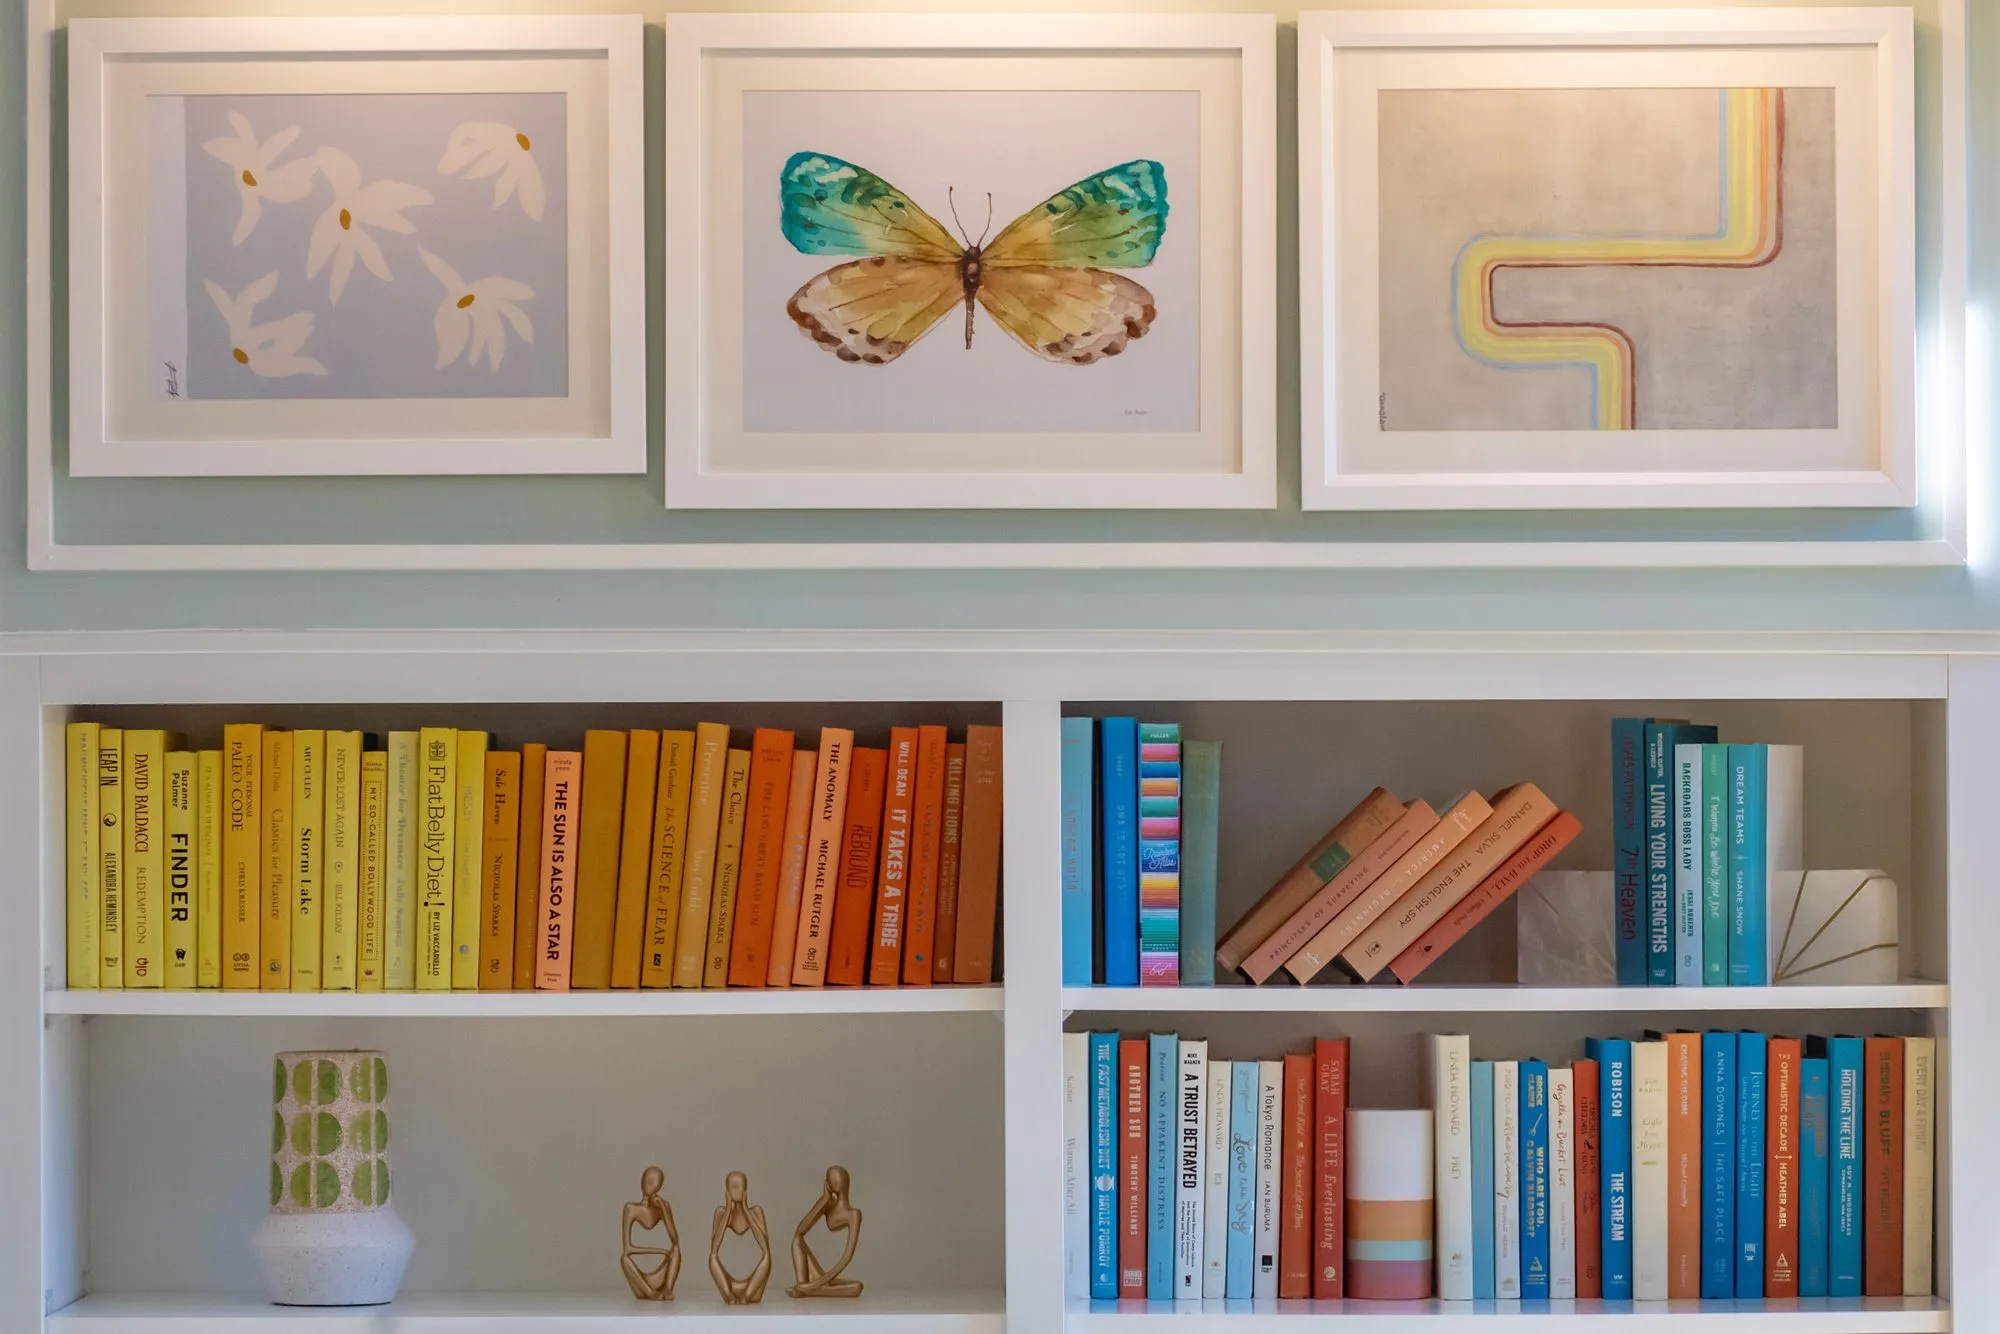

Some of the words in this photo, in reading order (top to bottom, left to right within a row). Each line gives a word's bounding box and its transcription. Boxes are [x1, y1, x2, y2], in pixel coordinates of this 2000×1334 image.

[100, 748, 118, 772] LEAP
[135, 753, 149, 790] DAVID
[231, 741, 244, 783] PALEO
[304, 745, 312, 763] ART
[335, 748, 346, 785] NEVER
[829, 742, 841, 765] THE
[898, 741, 911, 766] WILL
[100, 776, 118, 787] IN
[172, 772, 181, 808] Palmer
[181, 769, 190, 811] Suzanne
[369, 787, 377, 801] MY
[494, 768, 506, 789] Safe
[554, 781, 568, 811] THE
[731, 769, 745, 789] The
[823, 767, 838, 823] ANOMALY
[895, 767, 908, 797] DEAN
[946, 757, 963, 811] KILLING
[1682, 762, 1692, 819] BACKROADS
[1735, 766, 1745, 805] DREAM
[231, 787, 244, 832] CODE
[335, 785, 346, 811] LOST
[665, 807, 675, 823] The
[728, 792, 742, 825] Choice
[891, 808, 907, 824] IT
[1649, 784, 1666, 828] LIVING
[135, 795, 149, 853] BALDACCI
[271, 808, 283, 853] Classics
[334, 813, 345, 848] AGAIN
[368, 804, 377, 863] SO-CALLED
[553, 814, 567, 846] SUN
[944, 812, 959, 845] LIONS
[1503, 801, 1533, 833] DANIEL
[1682, 821, 1692, 846] BOSS
[1735, 807, 1745, 845] TEAMS
[300, 828, 313, 873] Storm
[552, 850, 564, 863] IS
[658, 825, 675, 893] SCIENCE
[846, 824, 873, 889] REBOUND
[886, 829, 906, 881] TAKES
[1476, 829, 1502, 856] SILVA
[1531, 835, 1557, 859] DROP
[1651, 830, 1667, 869] YOUR
[1682, 846, 1692, 871] LADY
[105, 852, 116, 895] ALEXANDRA
[171, 833, 189, 922] FINDER
[238, 862, 247, 888] CHRIS
[814, 839, 829, 891] MICHAEL
[1454, 859, 1472, 879] THE
[271, 873, 283, 920] Pleasure
[300, 879, 313, 915] Lake
[366, 866, 376, 930] BOLLYWOOD
[549, 866, 563, 907] ALSO
[722, 863, 734, 908] NICHOLAS
[884, 885, 901, 898] A
[1420, 872, 1456, 909] ENGLISH
[1735, 871, 1744, 907] SHANE
[105, 897, 117, 933] HEMINSLEY
[136, 867, 148, 944] REDEMPTION
[433, 911, 440, 921] BY
[549, 909, 561, 921] A
[808, 893, 823, 938] RUTGER
[1399, 906, 1422, 929] SPY
[1620, 873, 1640, 941] Heaven
[1651, 873, 1668, 953] STRENGTHS
[1735, 907, 1744, 936] SNOW
[365, 932, 375, 955] LIFE
[546, 924, 561, 961] STAR
[654, 908, 668, 946] FEAR
[716, 911, 729, 945] SPARKS
[880, 903, 900, 948] TRIBE
[432, 932, 440, 976] VACCARIELLO
[1098, 1043, 1110, 1061] THE
[1715, 1050, 1725, 1083] ANNA
[1098, 1063, 1110, 1089] FAST
[1129, 1064, 1141, 1114] ANOTHER
[1184, 1073, 1199, 1083] A
[1265, 1085, 1274, 1093] A
[1320, 1064, 1329, 1093] GRAY
[1330, 1060, 1339, 1095] SARAH
[1611, 1061, 1623, 1117] ROBISON
[1779, 1061, 1788, 1112] OPTIMISTIC
[1916, 1056, 1928, 1087] EVERY
[1158, 1090, 1167, 1108] NO
[1183, 1085, 1199, 1125] TRUST
[1263, 1094, 1274, 1122] Tokyo
[1535, 1075, 1543, 1106] BROCK
[1750, 1070, 1763, 1121] JOURNEY
[1840, 1068, 1853, 1114] HOLDING
[1916, 1089, 1928, 1107] DAY
[1098, 1088, 1110, 1147] METABOLISM
[1129, 1118, 1141, 1139] SUN
[1325, 1116, 1337, 1125] A
[1449, 1085, 1460, 1136] HOWARD
[1715, 1085, 1725, 1136] DOWNES
[1840, 1116, 1853, 1135] THE
[1158, 1112, 1167, 1171] APPARENT
[1263, 1124, 1274, 1170] Romance
[1324, 1133, 1337, 1168] LIFE
[1557, 1132, 1568, 1165] Bucket
[1779, 1114, 1788, 1152] DECADE
[1840, 1136, 1853, 1159] LINE
[1879, 1110, 1891, 1156] BLUFF
[1098, 1148, 1110, 1170] DIET
[1130, 1155, 1138, 1192] TIMOTHY
[1182, 1127, 1198, 1189] BETRAYED
[1526, 1140, 1535, 1183] CALVIN
[1535, 1146, 1544, 1175] WHO
[1715, 1152, 1725, 1174] THE
[1535, 1177, 1544, 1199] ARE
[1558, 1167, 1568, 1189] List
[1611, 1172, 1625, 1194] THE
[1715, 1177, 1725, 1204] SAFE
[1750, 1162, 1763, 1199] LIGHT
[1778, 1162, 1788, 1205] HEATHER
[1098, 1194, 1110, 1226] HAYLIE
[1130, 1195, 1138, 1236] WILLIAMS
[1157, 1175, 1167, 1231] DISTRESS
[1320, 1174, 1337, 1251] Everlasting
[1611, 1196, 1625, 1242] STREAM
[1778, 1206, 1787, 1229] ABEL
[1715, 1208, 1725, 1245] PLACE
[1098, 1227, 1110, 1268] POMROY
